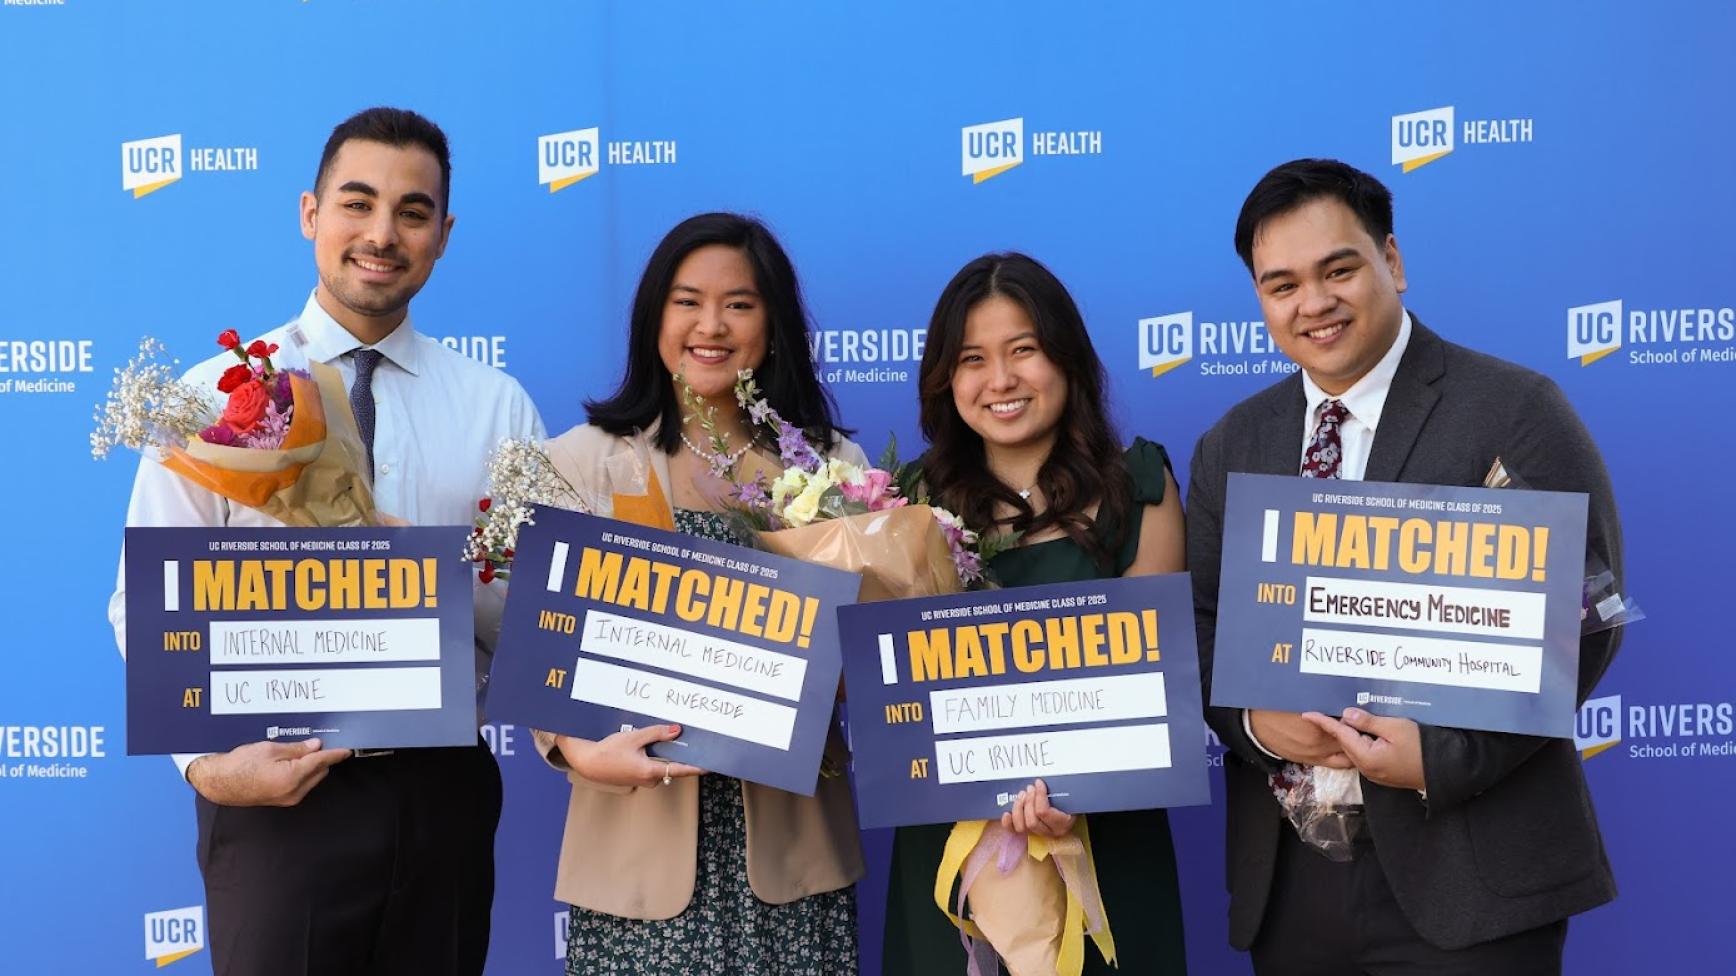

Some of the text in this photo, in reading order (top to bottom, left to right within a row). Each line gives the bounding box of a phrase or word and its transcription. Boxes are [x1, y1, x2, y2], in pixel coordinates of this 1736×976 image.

[969, 131, 1102, 158] UCR HEALTH
[1399, 119, 1533, 147] UCR HEALTH
[129, 147, 257, 173] UCR HEALTH
[546, 141, 676, 167] UCR HEALTH
[1147, 323, 1183, 355] UC
[1576, 308, 1736, 344] UC RIVERS
[1200, 361, 1248, 375] School
[1252, 360, 1268, 374] of
[1630, 350, 1677, 364] School
[1681, 348, 1696, 362] of
[15, 378, 76, 393] Medicine
[827, 369, 842, 383] of
[845, 368, 908, 382] Medicine
[1312, 493, 1502, 515] UC RIVERSIDE SCHOOL OF MEDICINE CLASS OF 2025
[209, 540, 390, 551] UC RIVERSIDE SCHOOL OF MEDICINE CLASS OF 2025
[602, 532, 778, 579] UC RIVERSIDE SCHOOL OF MEDICINE CLASS OF 2025
[1261, 509, 1549, 582] I MATCHED!
[164, 558, 438, 612] I MATCHED!
[547, 542, 819, 648] I MATCHED!
[1257, 583, 1296, 605] INTO
[921, 594, 1107, 621] UC RIVERSIDE SCHOOL OF MEDICINE CLASS OF 2025
[1310, 587, 1511, 628] EMERGENCY MEDICINE
[538, 610, 576, 634] INTO
[164, 632, 201, 651] INTO
[223, 628, 389, 657] INTERNAL MEDICINE
[594, 618, 784, 678] INTERNAL MEDICINE
[878, 609, 1161, 685] I MATCHED!
[1271, 643, 1292, 664] AT
[1304, 638, 1522, 677] RIVERSIDE COMMUNITY HOSPITAL
[225, 678, 326, 705] UC IRVINE
[545, 669, 567, 688] AT
[183, 688, 202, 708] AT
[625, 678, 744, 718] UC RIVERSIDE
[945, 689, 1105, 723] FAMILY MEDICINE
[885, 703, 924, 724] INTO
[1576, 703, 1733, 738] UC RIVERS
[949, 740, 1055, 776] UC IRVINE
[1630, 744, 1677, 758] School
[1681, 743, 1696, 756] of
[10, 764, 25, 777] of
[28, 763, 87, 777] Medicine
[910, 758, 928, 779] AT
[152, 918, 197, 943] UCR
